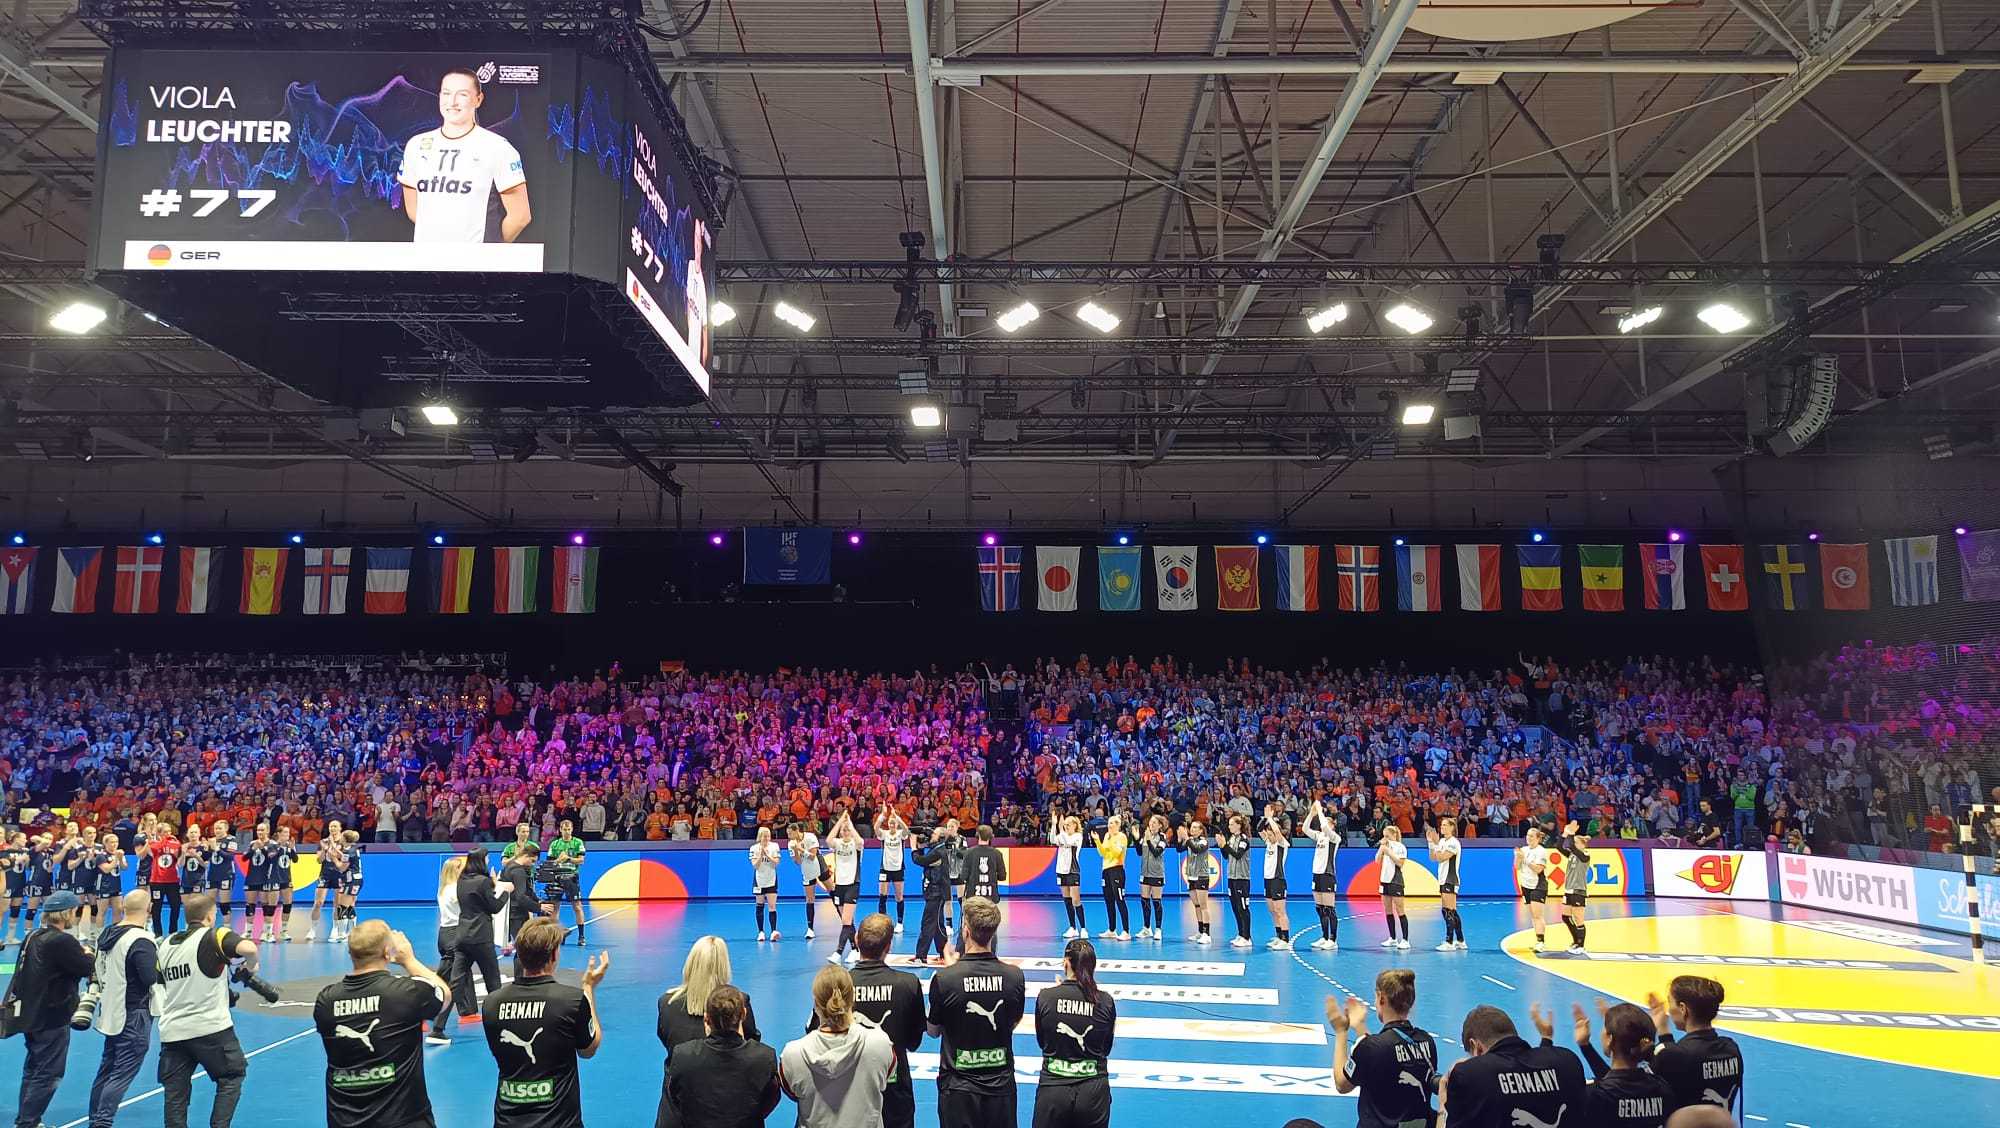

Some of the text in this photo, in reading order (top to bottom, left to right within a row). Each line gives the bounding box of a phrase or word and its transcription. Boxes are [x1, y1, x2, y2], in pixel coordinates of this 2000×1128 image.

[149, 86, 236, 109] VIOLA
[146, 119, 292, 143] LEUCHTER
[438, 149, 461, 172] 77
[634, 123, 657, 178] VIOLA
[416, 175, 472, 194] atlas
[633, 157, 668, 228] LEUCHTER
[140, 189, 277, 217] #77
[180, 251, 221, 260] GER
[631, 225, 664, 284] #77
[853, 985, 893, 1002] ERMANY
[963, 976, 1003, 993] GERMANY
[333, 995, 380, 1017] GERMANY
[499, 1001, 546, 1020] GERMANY
[1056, 998, 1095, 1017] GERMANY
[961, 1049, 1006, 1064] ALSCO
[1050, 1059, 1096, 1074] ALSCO
[1702, 1057, 1739, 1080] GERMANY
[500, 1080, 552, 1098] ALSCO
[1498, 1069, 1560, 1094] GERMANY
[1618, 1097, 1663, 1118] GERMANY
